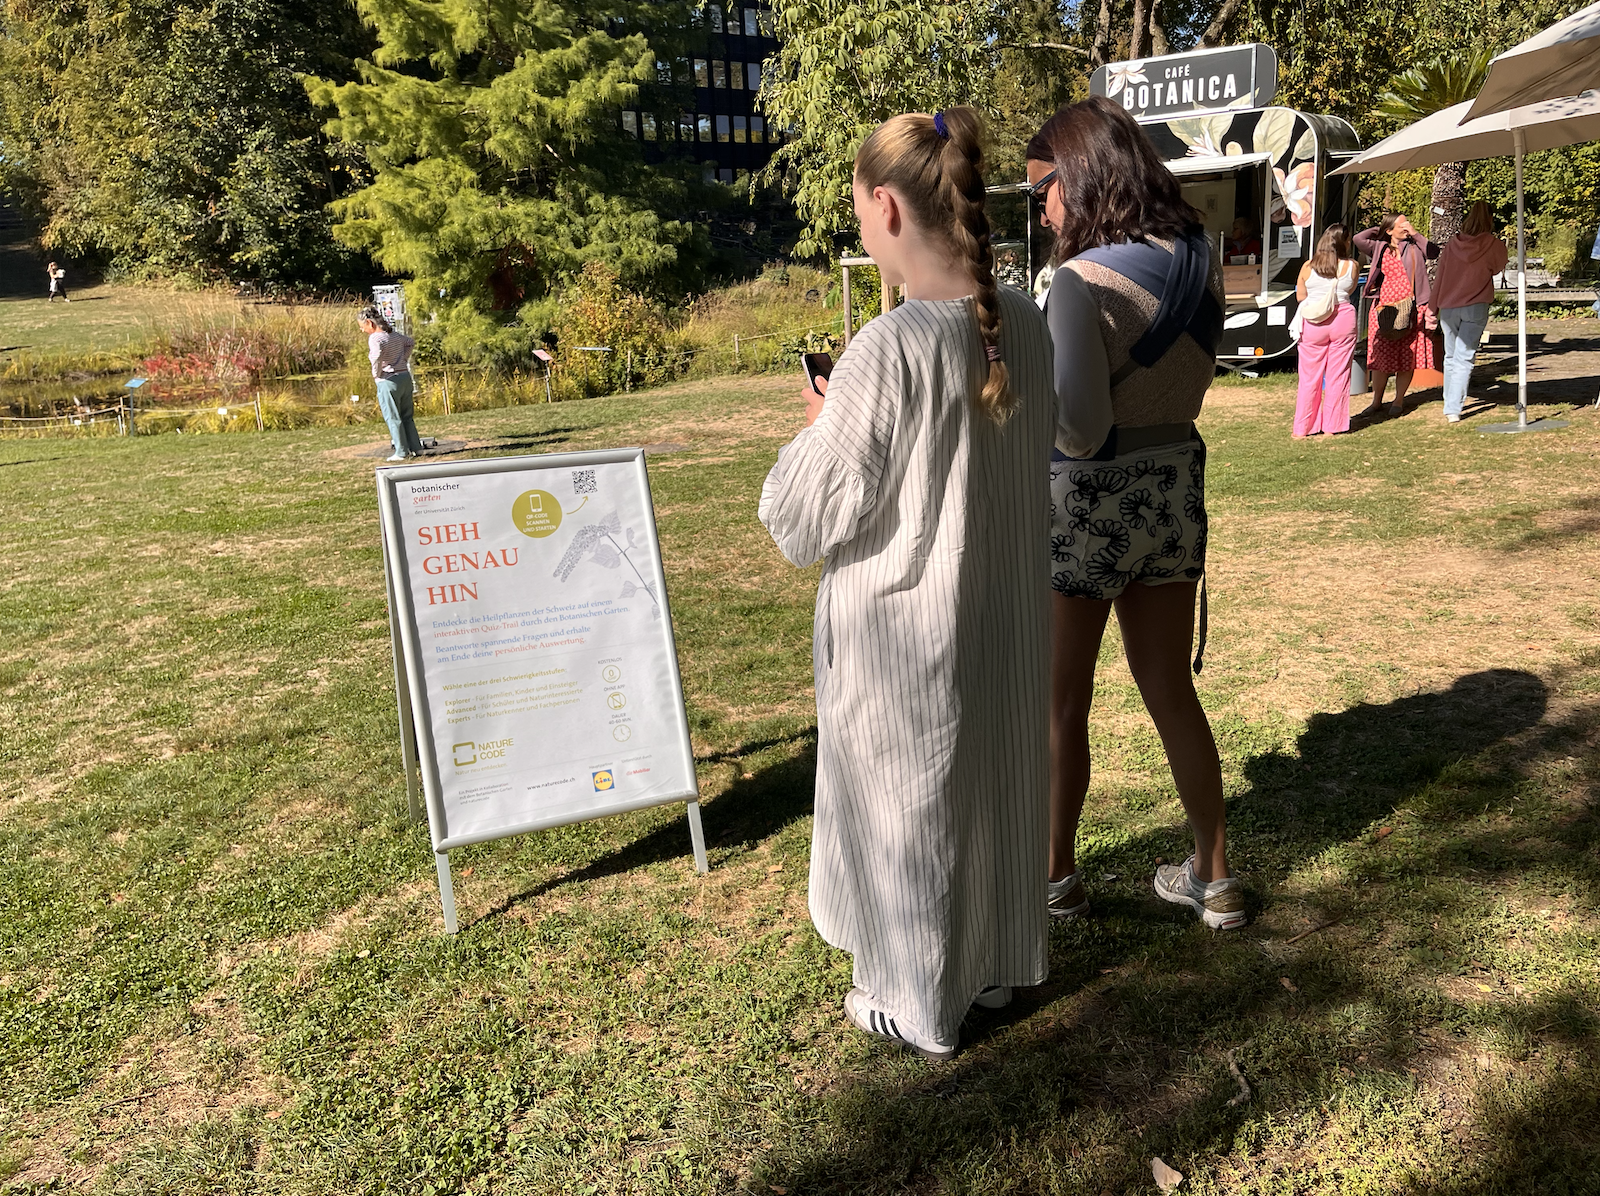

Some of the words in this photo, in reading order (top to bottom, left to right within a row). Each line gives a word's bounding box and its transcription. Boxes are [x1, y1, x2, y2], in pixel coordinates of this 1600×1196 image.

[1165, 63, 1190, 79] CAFÉ
[1123, 74, 1236, 110] BOTANICA
[411, 483, 459, 493] botanischer
[413, 495, 440, 505] garten
[418, 522, 481, 545] SIEH
[423, 548, 518, 574] GENAU
[426, 582, 478, 605] HIN
[433, 616, 467, 628] Entdecke
[482, 610, 530, 622] Heilpflanzen
[546, 604, 575, 613] Schweiz
[434, 628, 479, 638] interaktiven
[481, 621, 518, 632] Quiz-Trail
[520, 618, 542, 626] durch
[559, 610, 602, 621] Botanischen
[604, 607, 630, 615] Garten.
[436, 642, 479, 653] Beantworte
[481, 636, 521, 648] spannende
[522, 633, 548, 642] Fragen
[550, 629, 564, 637] und
[566, 626, 591, 635] erhalte
[451, 653, 470, 661] Ende
[473, 650, 493, 658] deine
[495, 643, 537, 657] persönliche
[539, 637, 586, 649] Auswertung.
[502, 668, 567, 682] Schwierigkeitsstufen:
[445, 698, 470, 706] Explorer
[487, 691, 514, 699] Familien,
[549, 681, 578, 690] Einsteiger
[447, 705, 476, 715] Advanced
[492, 699, 514, 708] Schüler
[530, 688, 583, 701] Naturinteressierte
[448, 716, 470, 724] Experts
[487, 708, 525, 717] Naturkenner
[540, 698, 580, 708] Fachpersonen
[478, 738, 514, 751] NATURE
[480, 749, 506, 760] CODE
[527, 777, 575, 790] www.naturecode.ch
